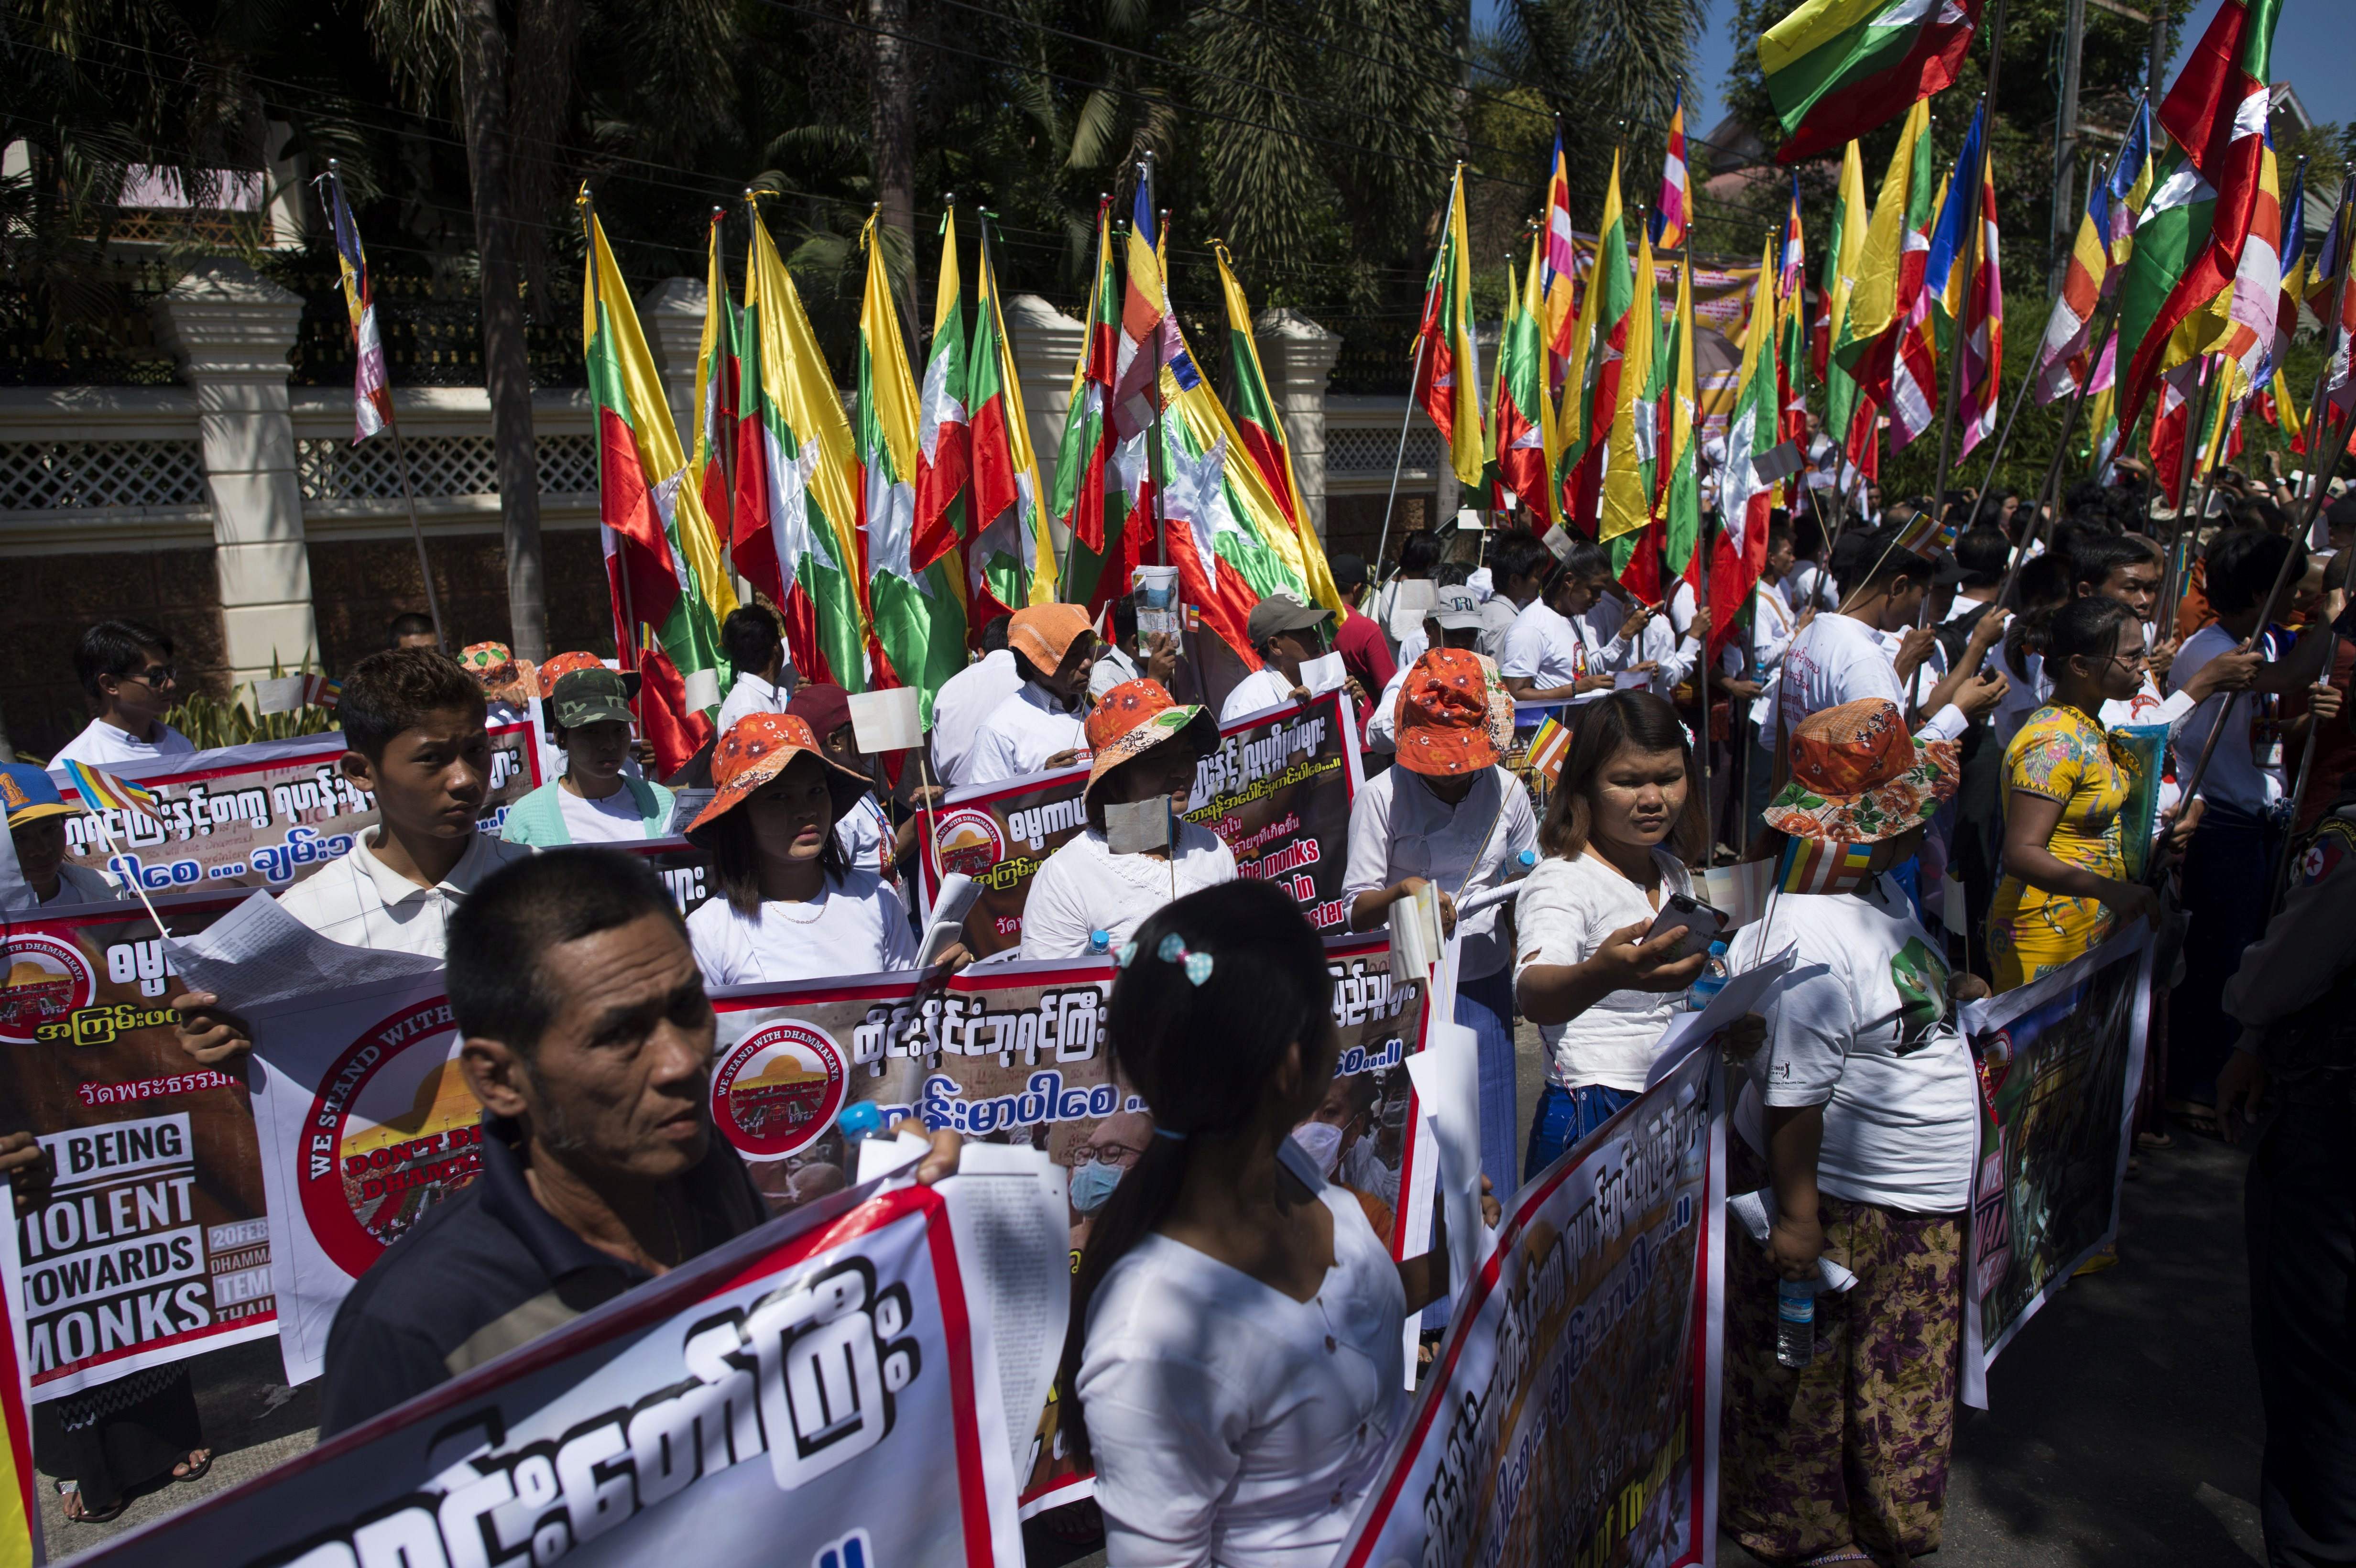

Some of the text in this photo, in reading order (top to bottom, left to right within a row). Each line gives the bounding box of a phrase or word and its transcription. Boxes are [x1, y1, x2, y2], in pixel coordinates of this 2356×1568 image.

[1451, 597, 1474, 611] TRI
[949, 817, 962, 828] WITH
[962, 816, 998, 842] DHAMMAKAYA
[1264, 838, 1320, 880] monks
[1293, 873, 1316, 902] in
[25, 943, 85, 981] DHAMMAKAYA
[718, 1030, 840, 1097] WE STAND WITH DHAMMAKAYA
[311, 1004, 456, 1180] WE STAND WITH
[68, 1123, 183, 1175] BEING
[347, 1134, 444, 1177] DON'T
[17, 1176, 196, 1260] IOLENT
